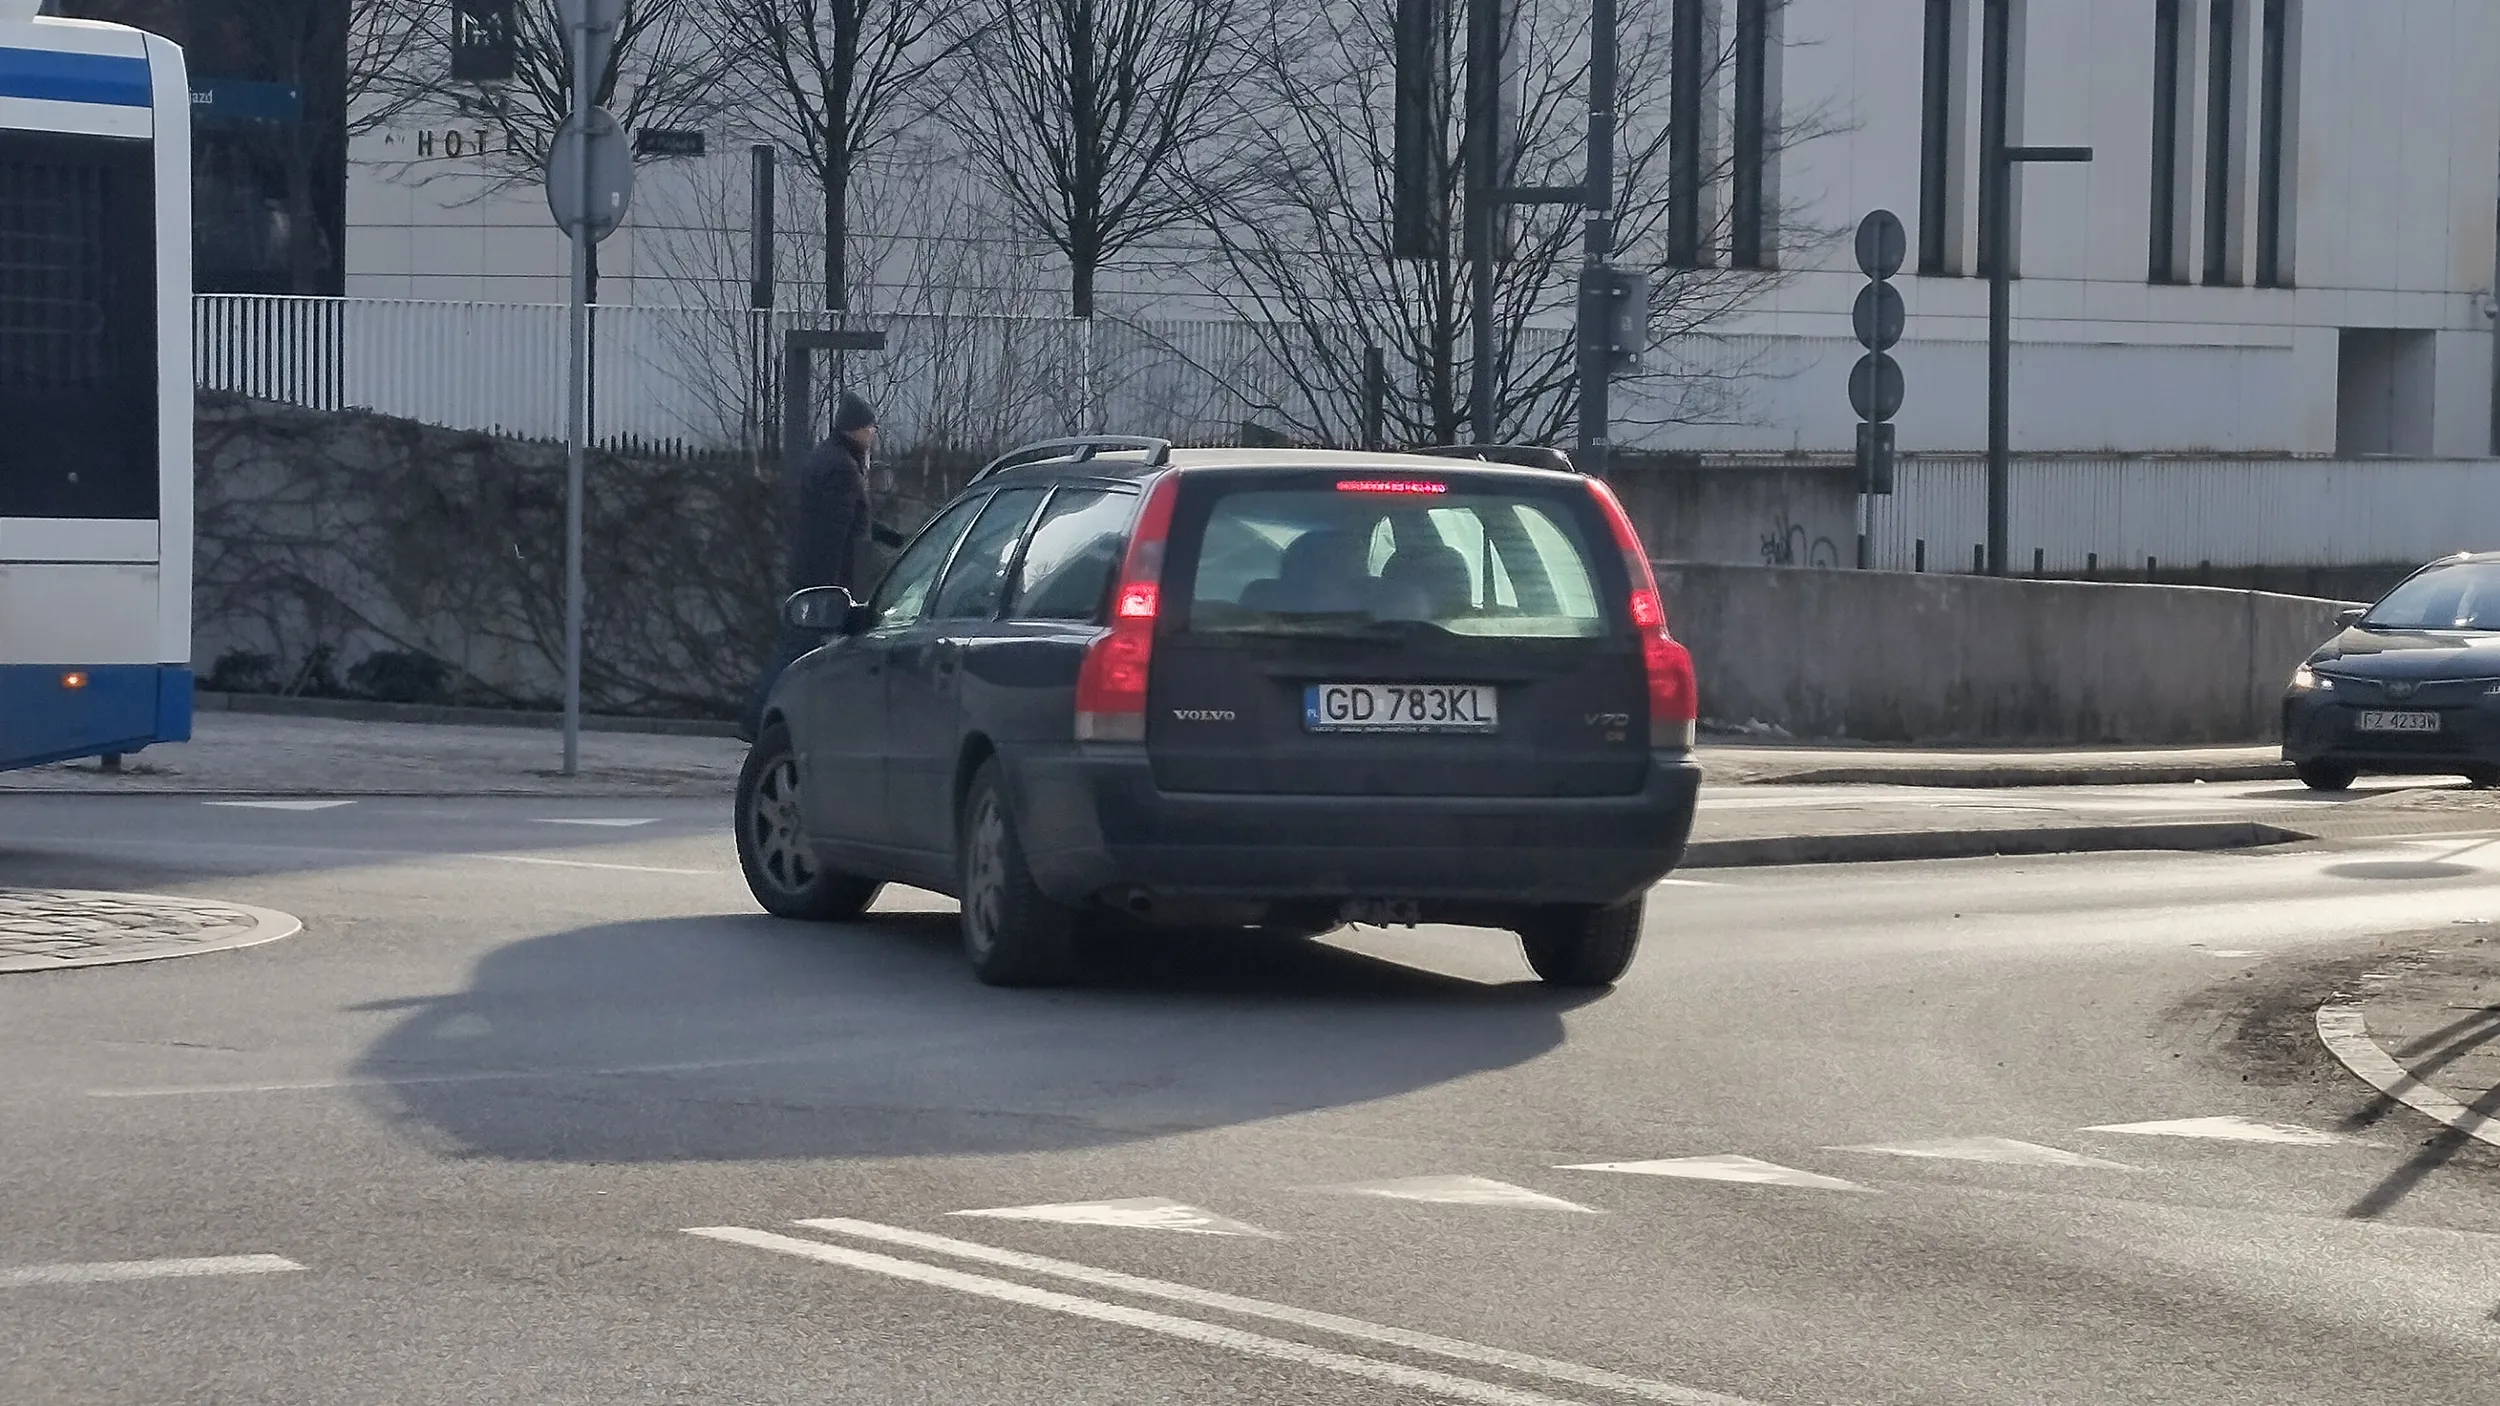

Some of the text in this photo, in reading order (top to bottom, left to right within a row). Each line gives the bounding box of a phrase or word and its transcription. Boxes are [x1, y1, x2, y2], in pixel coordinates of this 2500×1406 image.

[1326, 687, 1491, 722] GD 783KL
[1173, 709, 1236, 721] VOLVO
[1585, 713, 1630, 726] V70
[2364, 712, 2383, 728] FZ
